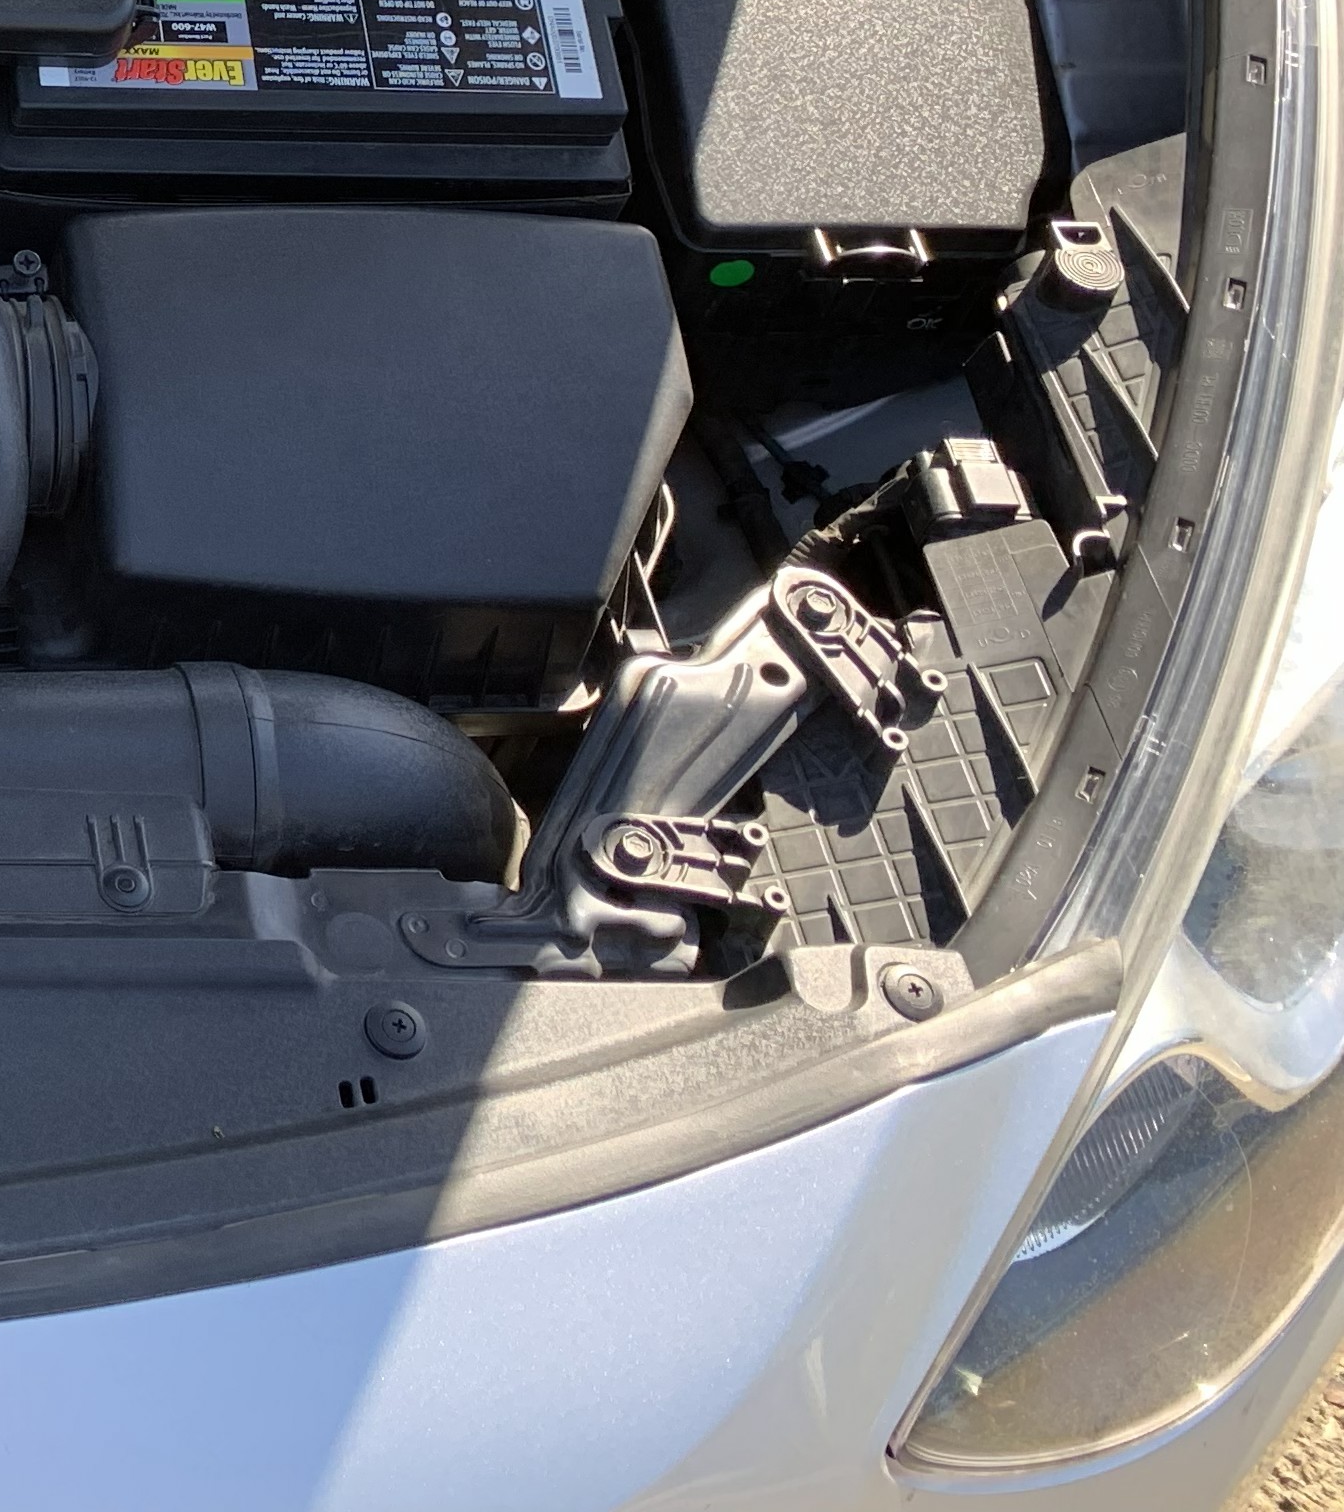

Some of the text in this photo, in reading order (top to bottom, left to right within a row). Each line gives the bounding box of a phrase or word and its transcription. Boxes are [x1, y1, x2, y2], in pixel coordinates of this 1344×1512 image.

[172, 23, 216, 31] W47-600
[123, 48, 160, 56] MAXX
[114, 58, 244, 87] EverStart
[325, 77, 370, 86] WARNING:
[467, 76, 530, 85] DANGER/POISON
